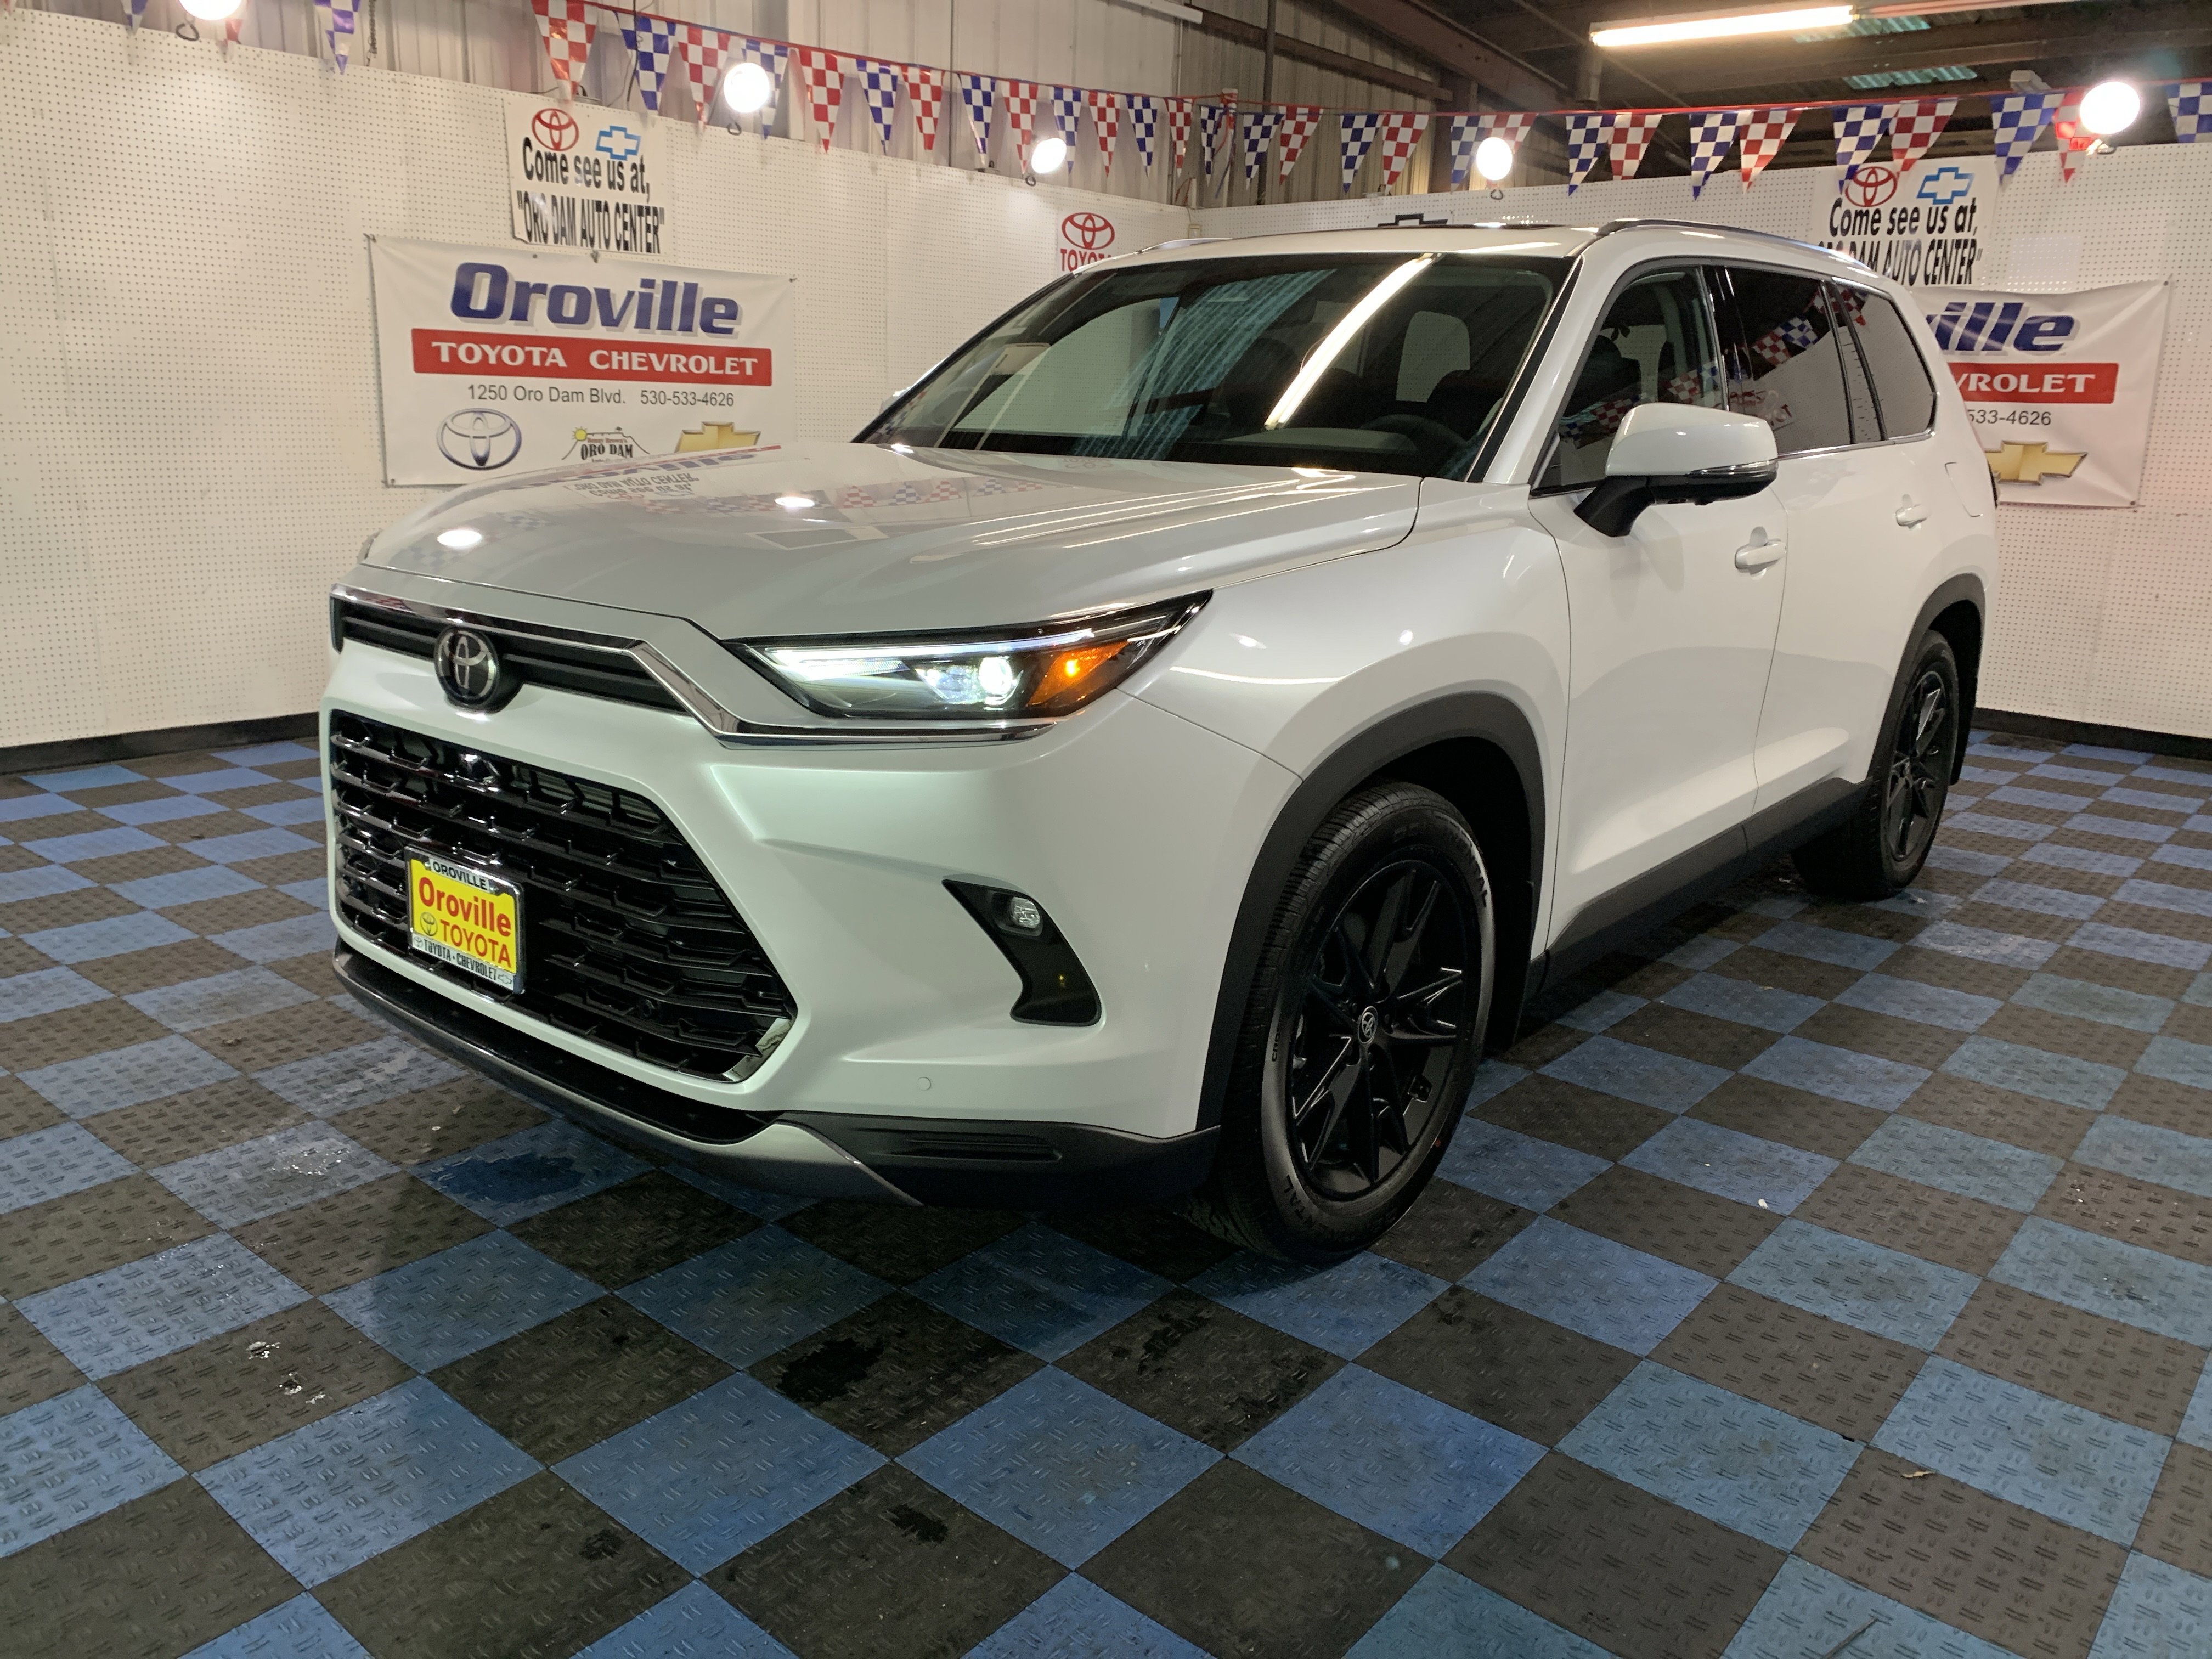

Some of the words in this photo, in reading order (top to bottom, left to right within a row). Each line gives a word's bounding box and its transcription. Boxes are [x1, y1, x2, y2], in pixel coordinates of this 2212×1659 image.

[523, 137, 569, 185] Come
[574, 155, 602, 189] see
[607, 160, 625, 191] us
[630, 155, 650, 204] at,
[551, 195, 576, 247] DAM
[581, 199, 611, 250] AUTO
[614, 201, 665, 254] CENTER"
[1829, 198, 1881, 237] Come
[1887, 206, 1920, 235] see
[1927, 205, 1948, 234] us
[1955, 198, 1978, 236] at,
[1060, 249, 1111, 272] TOYO
[1882, 238, 1922, 286] AUTO
[1924, 239, 1983, 285] CENTER"
[450, 262, 740, 335] Oroville
[431, 341, 567, 368] TOYOTA
[589, 349, 758, 376] CHEVROLET
[468, 384, 507, 402] 1250
[514, 385, 544, 402] Oro
[550, 387, 584, 403] Dam
[590, 387, 625, 404] Blvd.
[640, 390, 734, 407] 530-533-4626
[581, 444, 605, 460] ORO
[609, 444, 633, 459] DAM
[433, 861, 487, 890] OROVILLE
[419, 877, 511, 937] Oroville
[440, 919, 511, 968] TOYOTA
